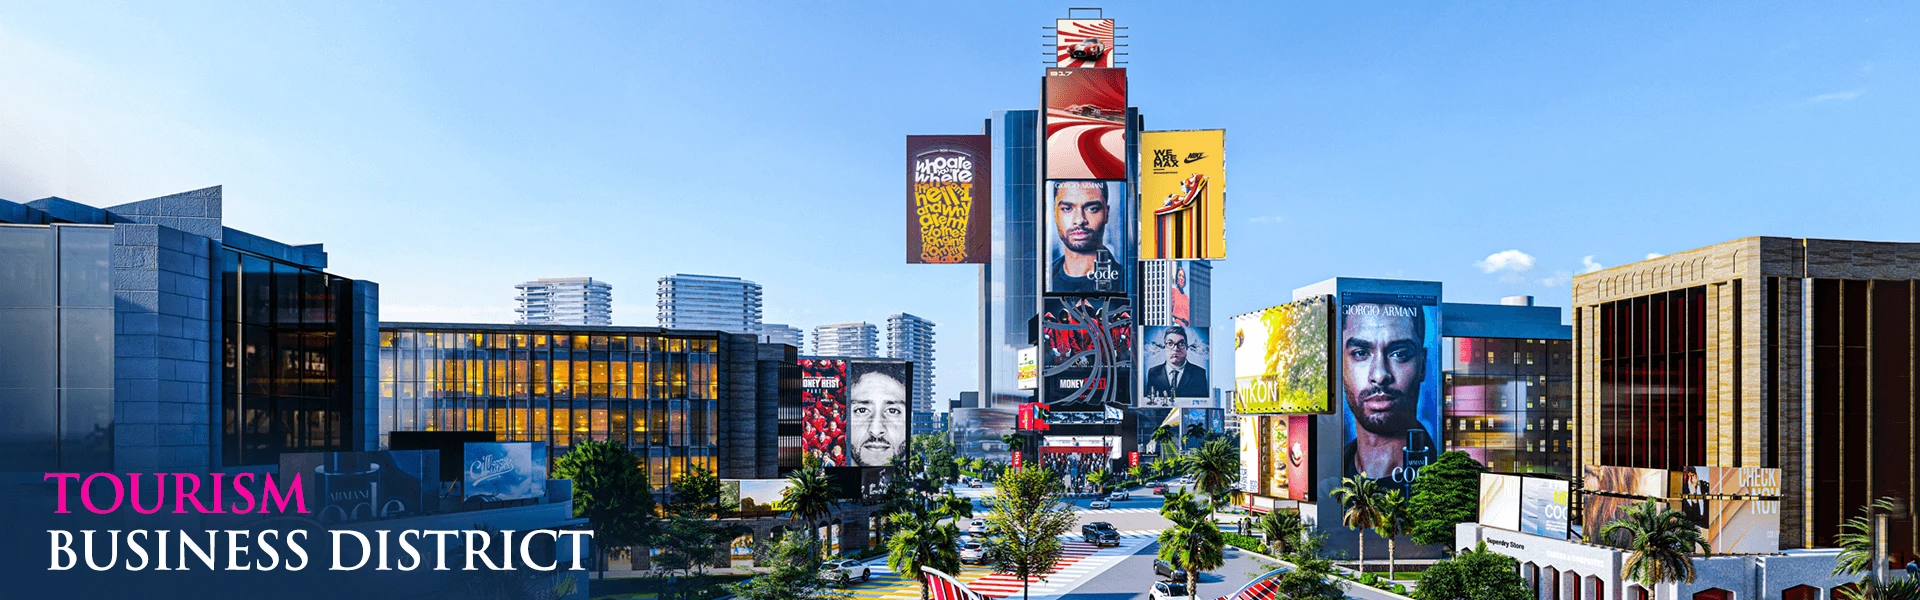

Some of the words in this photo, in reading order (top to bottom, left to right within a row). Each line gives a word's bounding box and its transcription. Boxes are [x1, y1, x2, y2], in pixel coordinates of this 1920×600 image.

[1153, 160, 1179, 168] MAX
[1087, 265, 1119, 280] code
[1342, 304, 1380, 316] GIORGIO
[1382, 306, 1418, 318] ARMANI
[1060, 379, 1085, 389] MONEY
[1738, 467, 1777, 488] CHECK
[1510, 540, 1525, 550] Store
